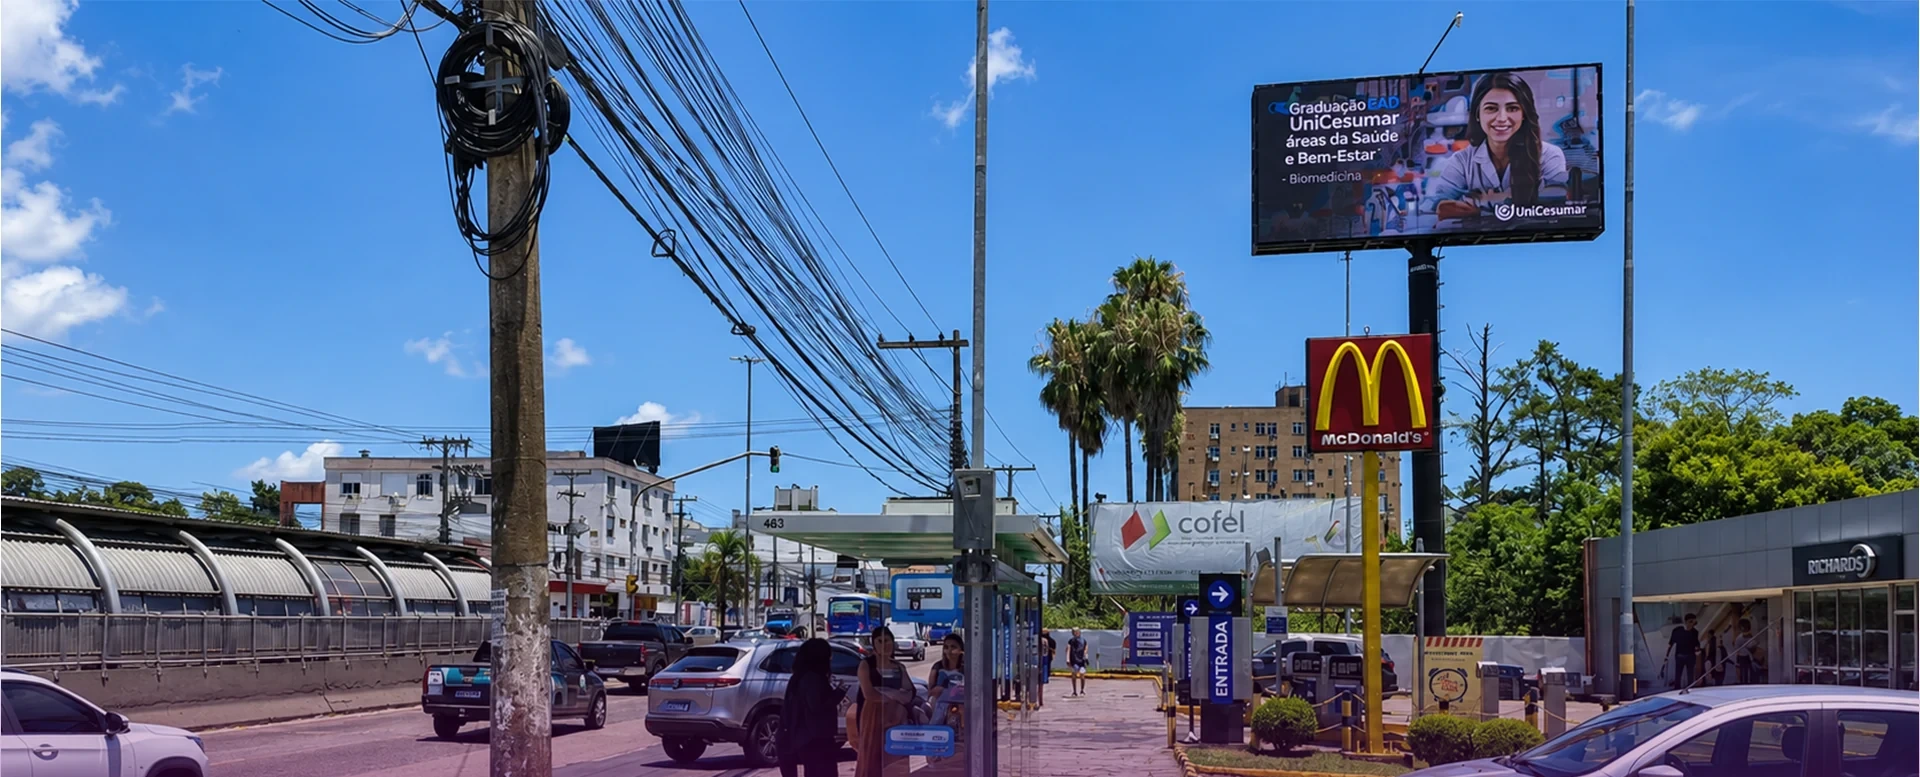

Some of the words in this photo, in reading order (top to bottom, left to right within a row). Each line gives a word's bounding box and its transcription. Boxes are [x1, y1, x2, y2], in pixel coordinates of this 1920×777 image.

[1289, 99, 1366, 115] Graduação
[1368, 96, 1399, 110] EAD
[1290, 113, 1400, 131] UniCesumar
[1286, 134, 1327, 148] áreas
[1330, 132, 1349, 146] da
[1352, 129, 1399, 144] Saúde
[1285, 155, 1295, 165] e
[1289, 171, 1362, 184] Biomedicina
[1516, 205, 1587, 217] UniCesumar
[1321, 432, 1422, 445] McDonald's
[764, 518, 784, 528] 463
[1178, 510, 1245, 533] cofel
[1808, 556, 1864, 574] RICHARDS
[1215, 621, 1228, 696] ENTRADA
